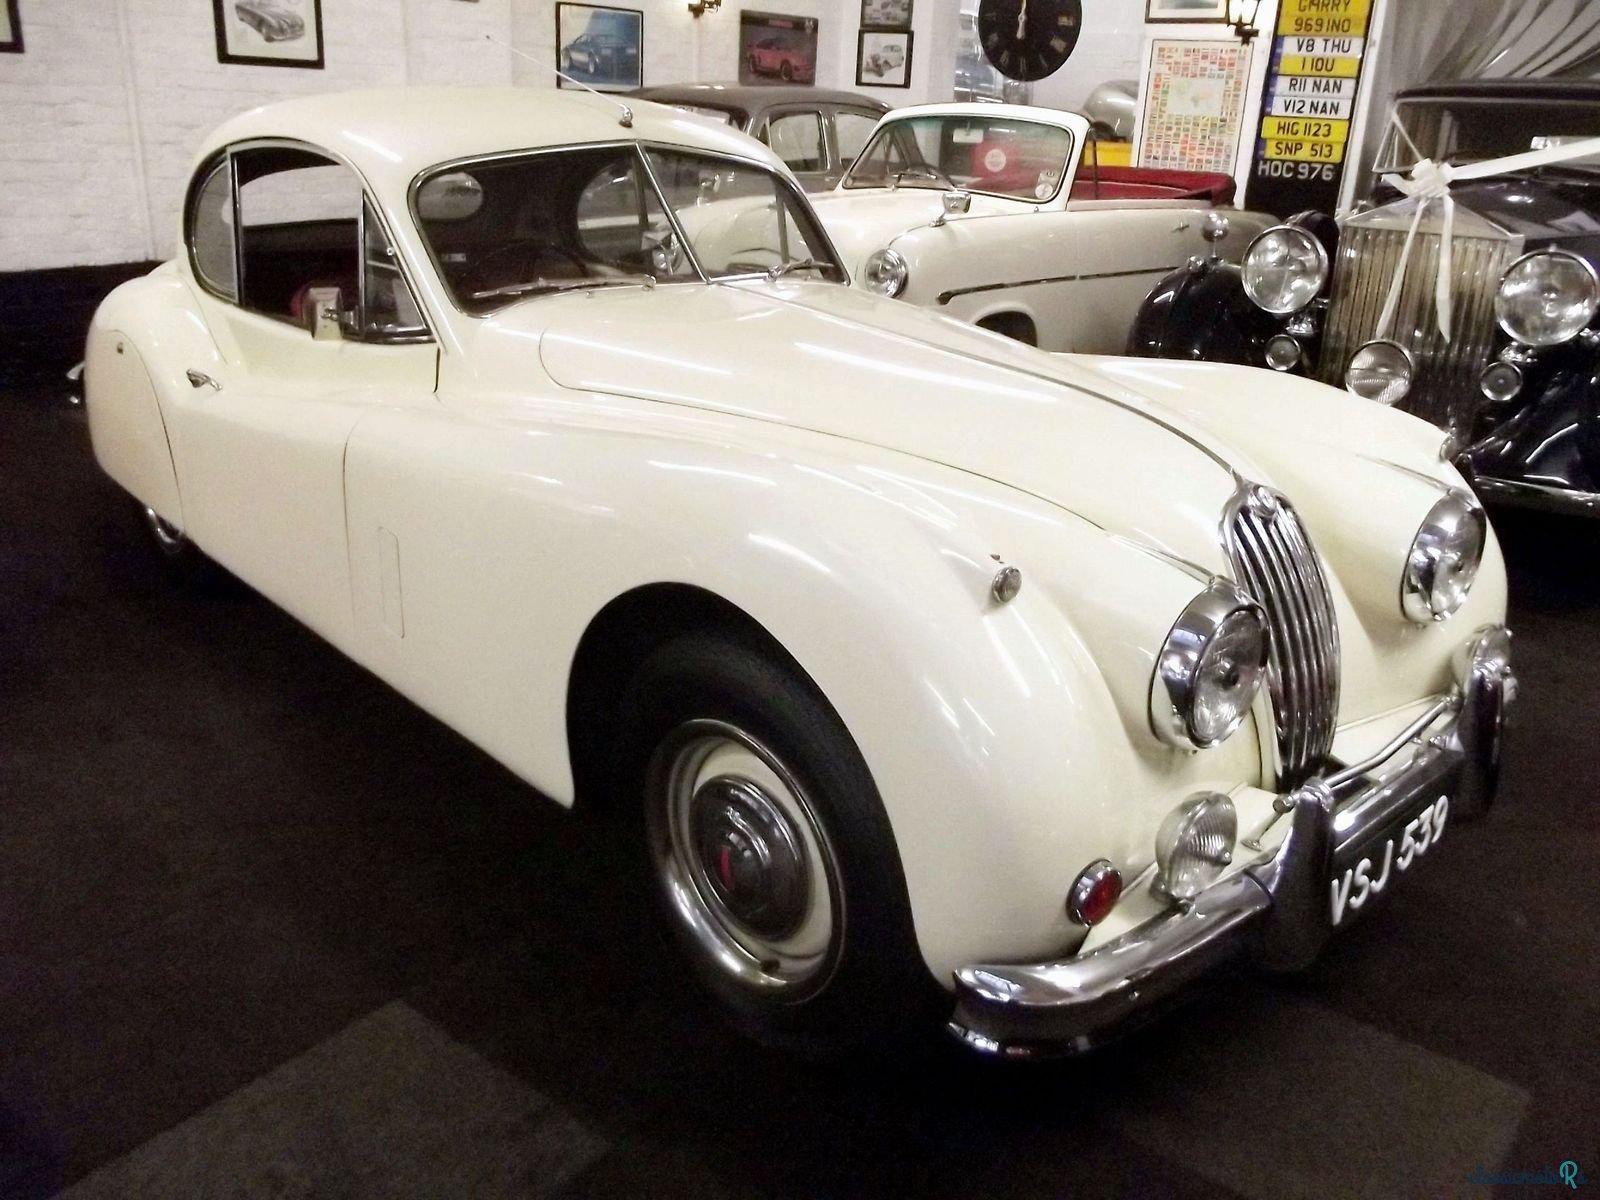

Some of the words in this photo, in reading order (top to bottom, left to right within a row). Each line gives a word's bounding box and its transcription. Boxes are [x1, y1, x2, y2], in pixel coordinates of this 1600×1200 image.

[1296, 38, 1315, 53] V8
[1322, 39, 1352, 54] THU
[1312, 79, 1343, 94] NAN
[1283, 99, 1306, 114] V12
[1309, 100, 1340, 116] NAN
[1303, 121, 1332, 138] 1123
[1274, 141, 1304, 157] SNP
[1309, 142, 1334, 159] 513
[1257, 160, 1295, 179] HOC
[1297, 162, 1334, 181] 976
[1331, 839, 1394, 926] VSJ
[1396, 794, 1449, 871] 539
